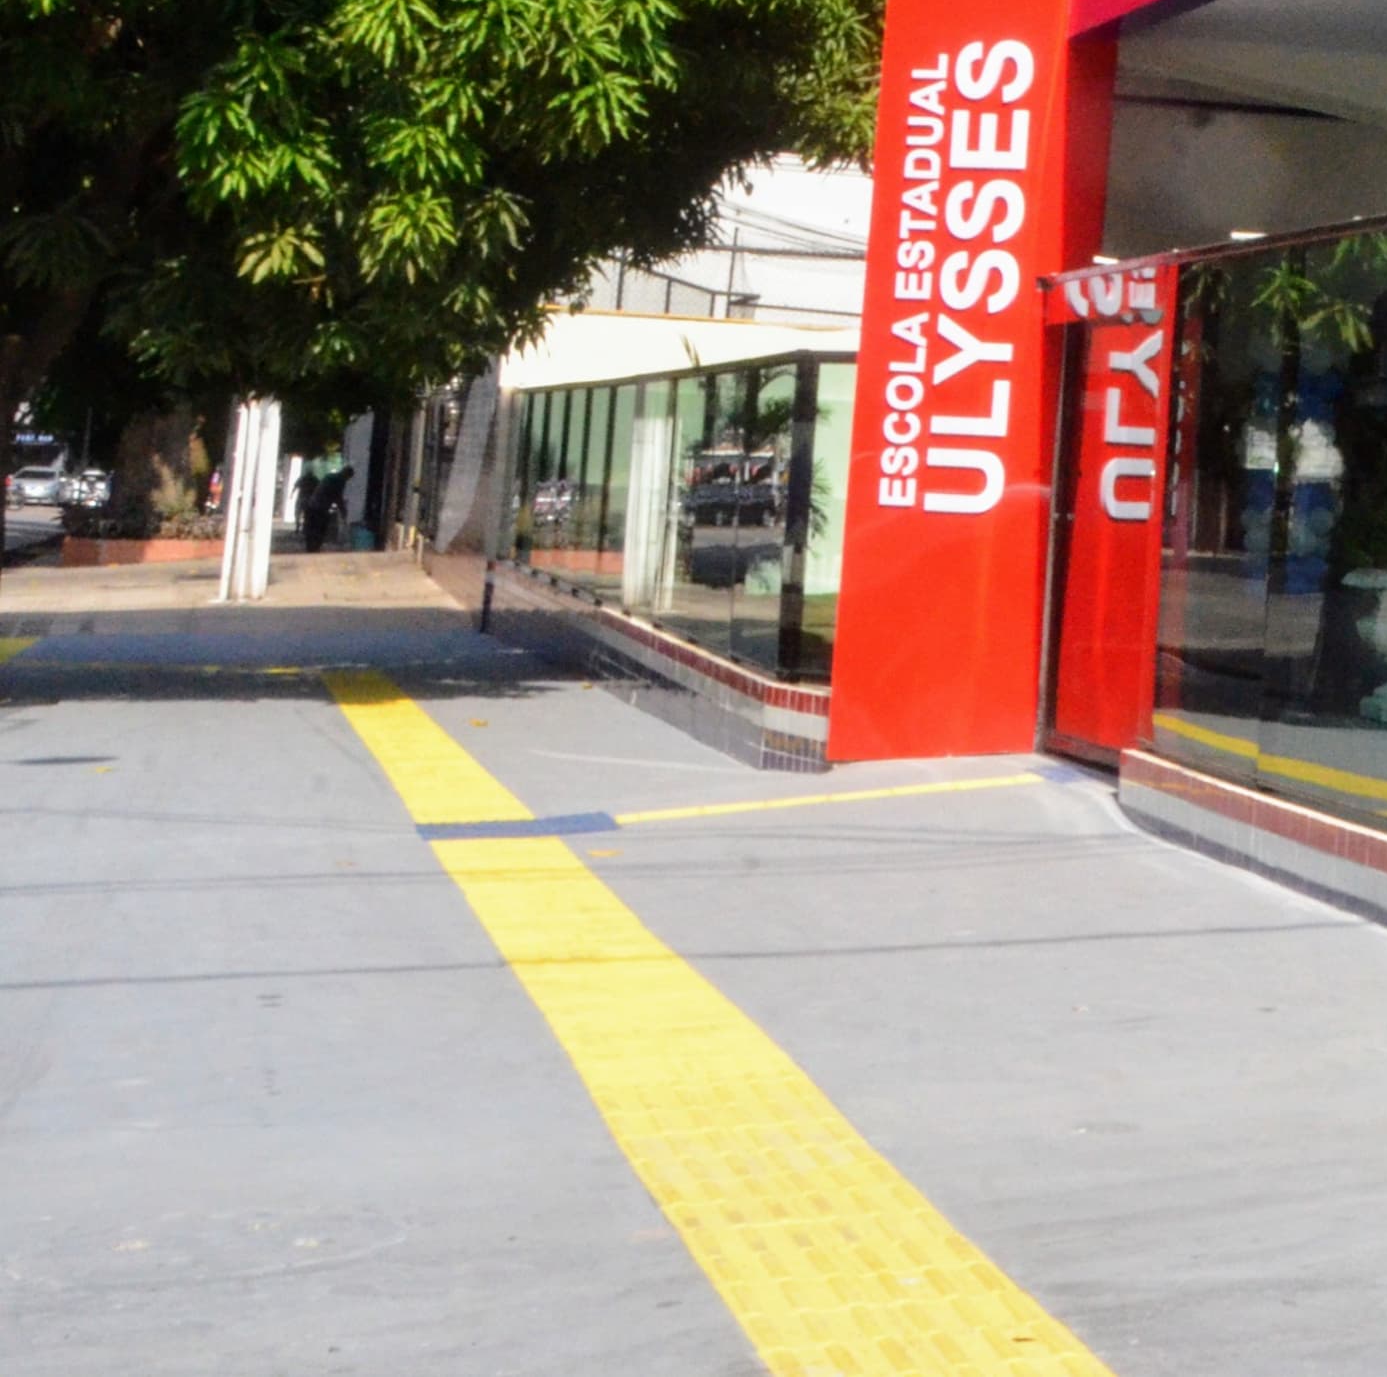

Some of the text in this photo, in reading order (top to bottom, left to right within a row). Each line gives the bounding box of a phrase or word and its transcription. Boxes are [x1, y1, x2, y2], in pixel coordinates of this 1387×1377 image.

[877, 52, 950, 508] ESCOLA ESTADUAL
[922, 38, 1036, 515] ULYSSES
